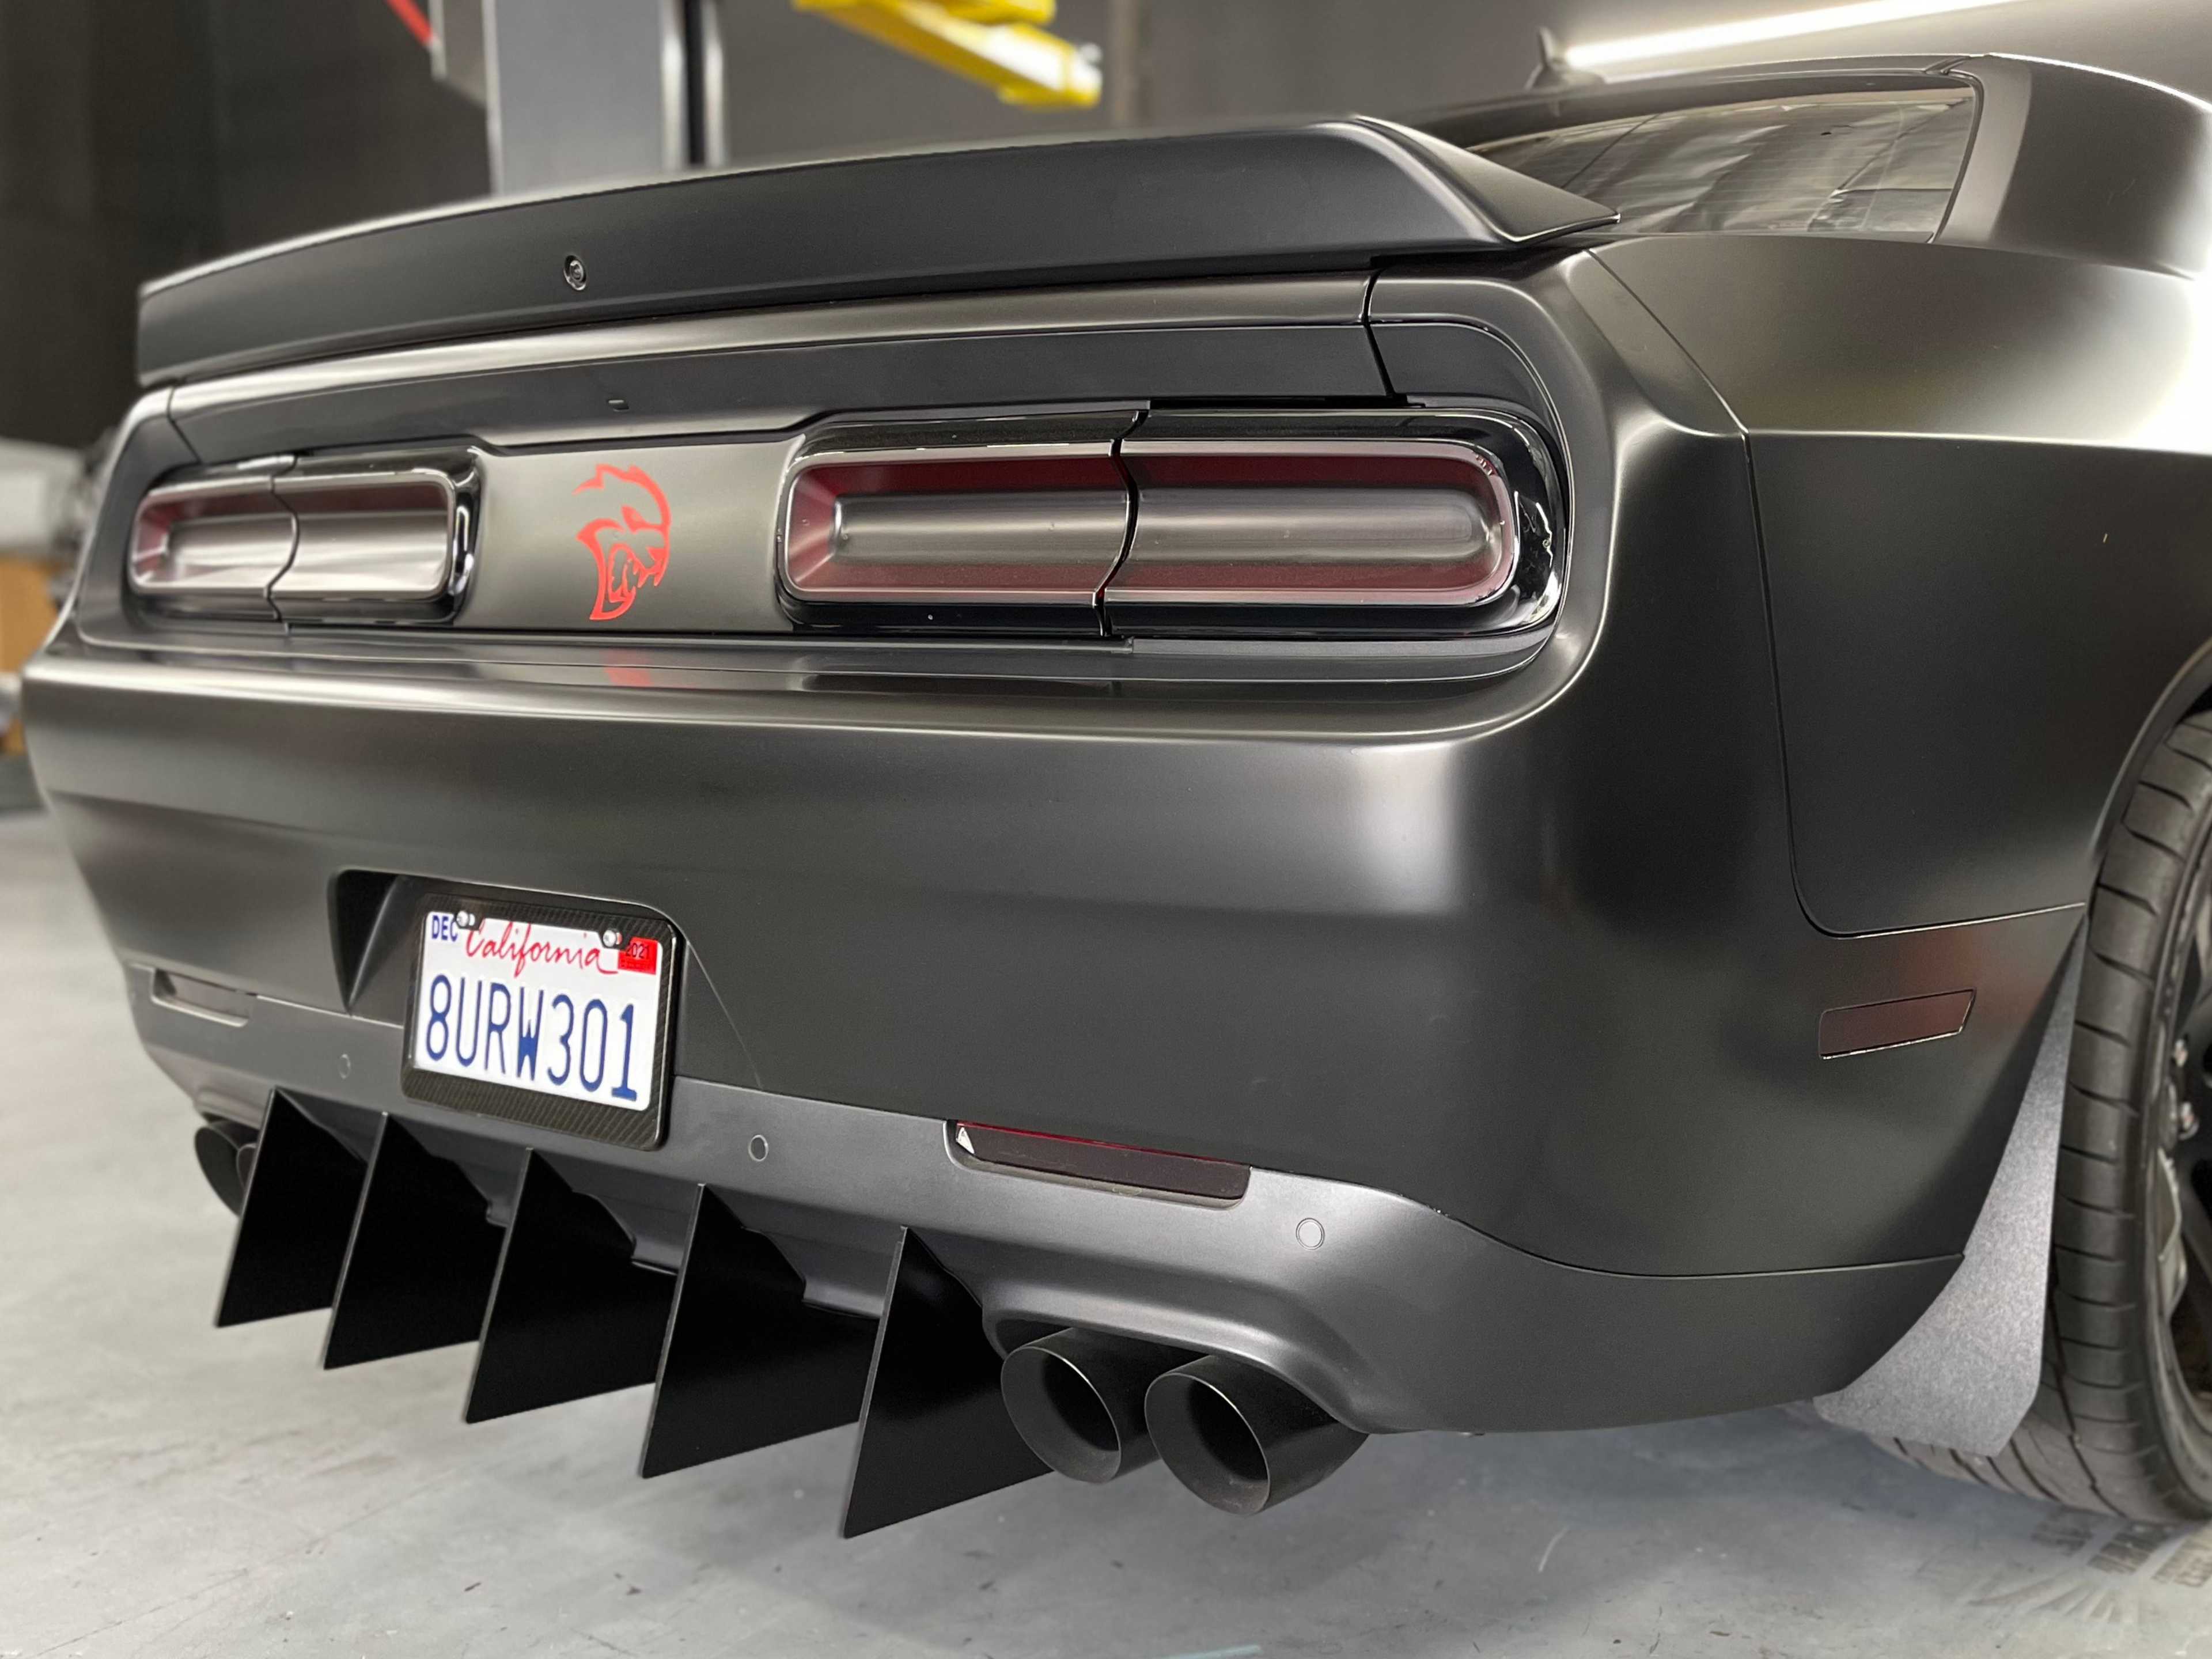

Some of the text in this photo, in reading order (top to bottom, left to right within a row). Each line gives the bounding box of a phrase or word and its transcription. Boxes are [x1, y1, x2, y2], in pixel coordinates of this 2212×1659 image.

[431, 915, 459, 942] DEC
[465, 918, 619, 978] California
[426, 974, 638, 1101] 8URW301
